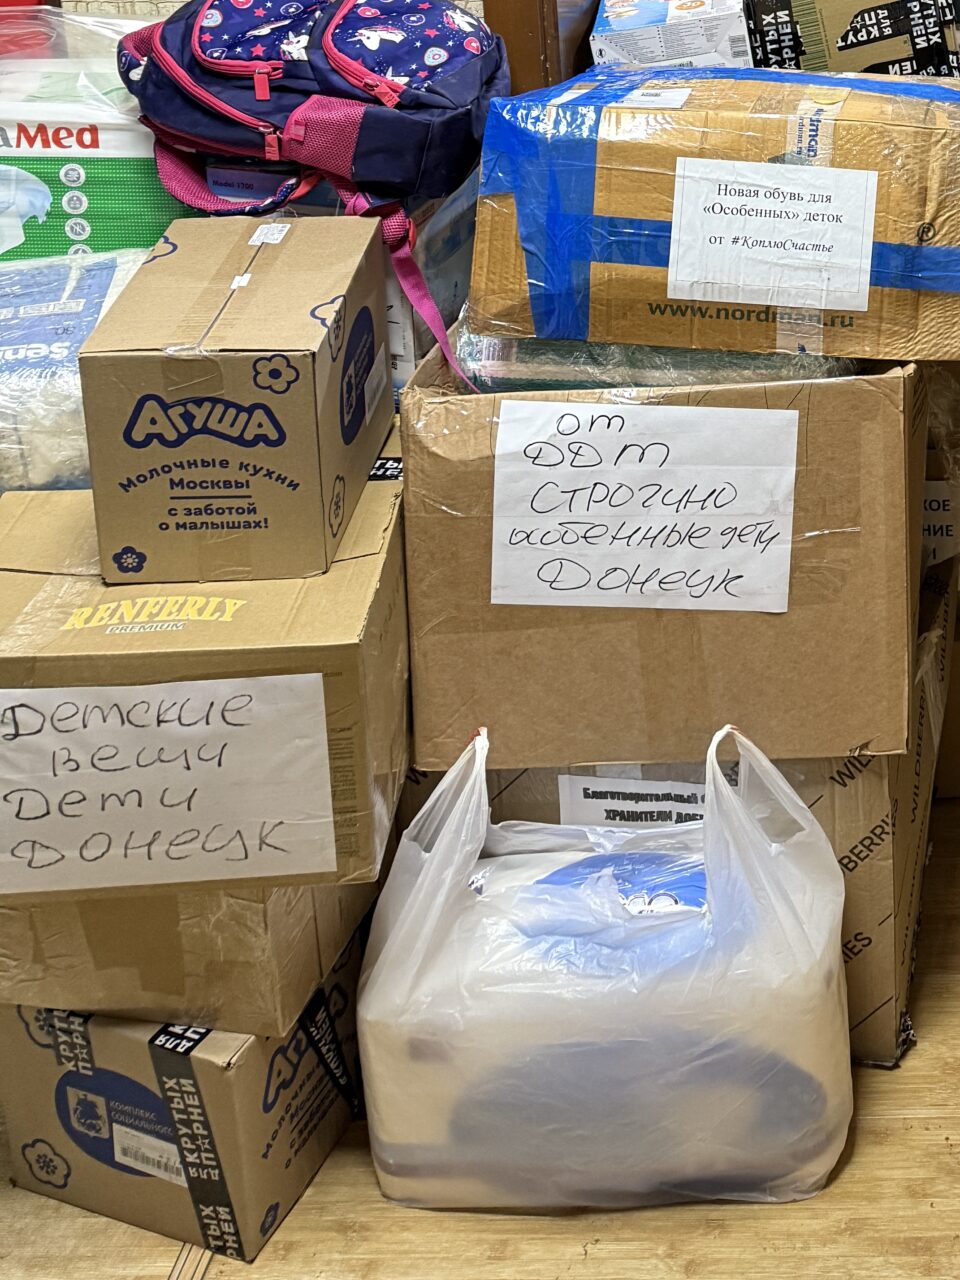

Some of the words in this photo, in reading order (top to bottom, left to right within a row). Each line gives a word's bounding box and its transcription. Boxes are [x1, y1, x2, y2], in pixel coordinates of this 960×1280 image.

[717, 183, 760, 199] Новая
[763, 187, 804, 203] обувь
[807, 192, 832, 204] для
[703, 202, 799, 221] «Особенных»
[803, 211, 843, 224] деток
[708, 235, 725, 246] от
[730, 234, 834, 254] #КоплюСчастье
[648, 302, 854, 328] www.nordman.ru
[118, 458, 230, 493] Молочные
[238, 460, 300, 491] кухни
[169, 477, 250, 490] Москвы
[167, 507, 178, 516] с
[183, 502, 257, 516] заботой
[158, 522, 170, 531] о
[175, 517, 269, 531] малышах!
[59, 596, 247, 630] RENFERLY
[106, 622, 187, 634] PREMIUM
[1, 693, 253, 741] Детские
[603, 808, 673, 823] ХРАНИТЕЛИ
[162, 1076, 201, 1163] КРУТЫХ
